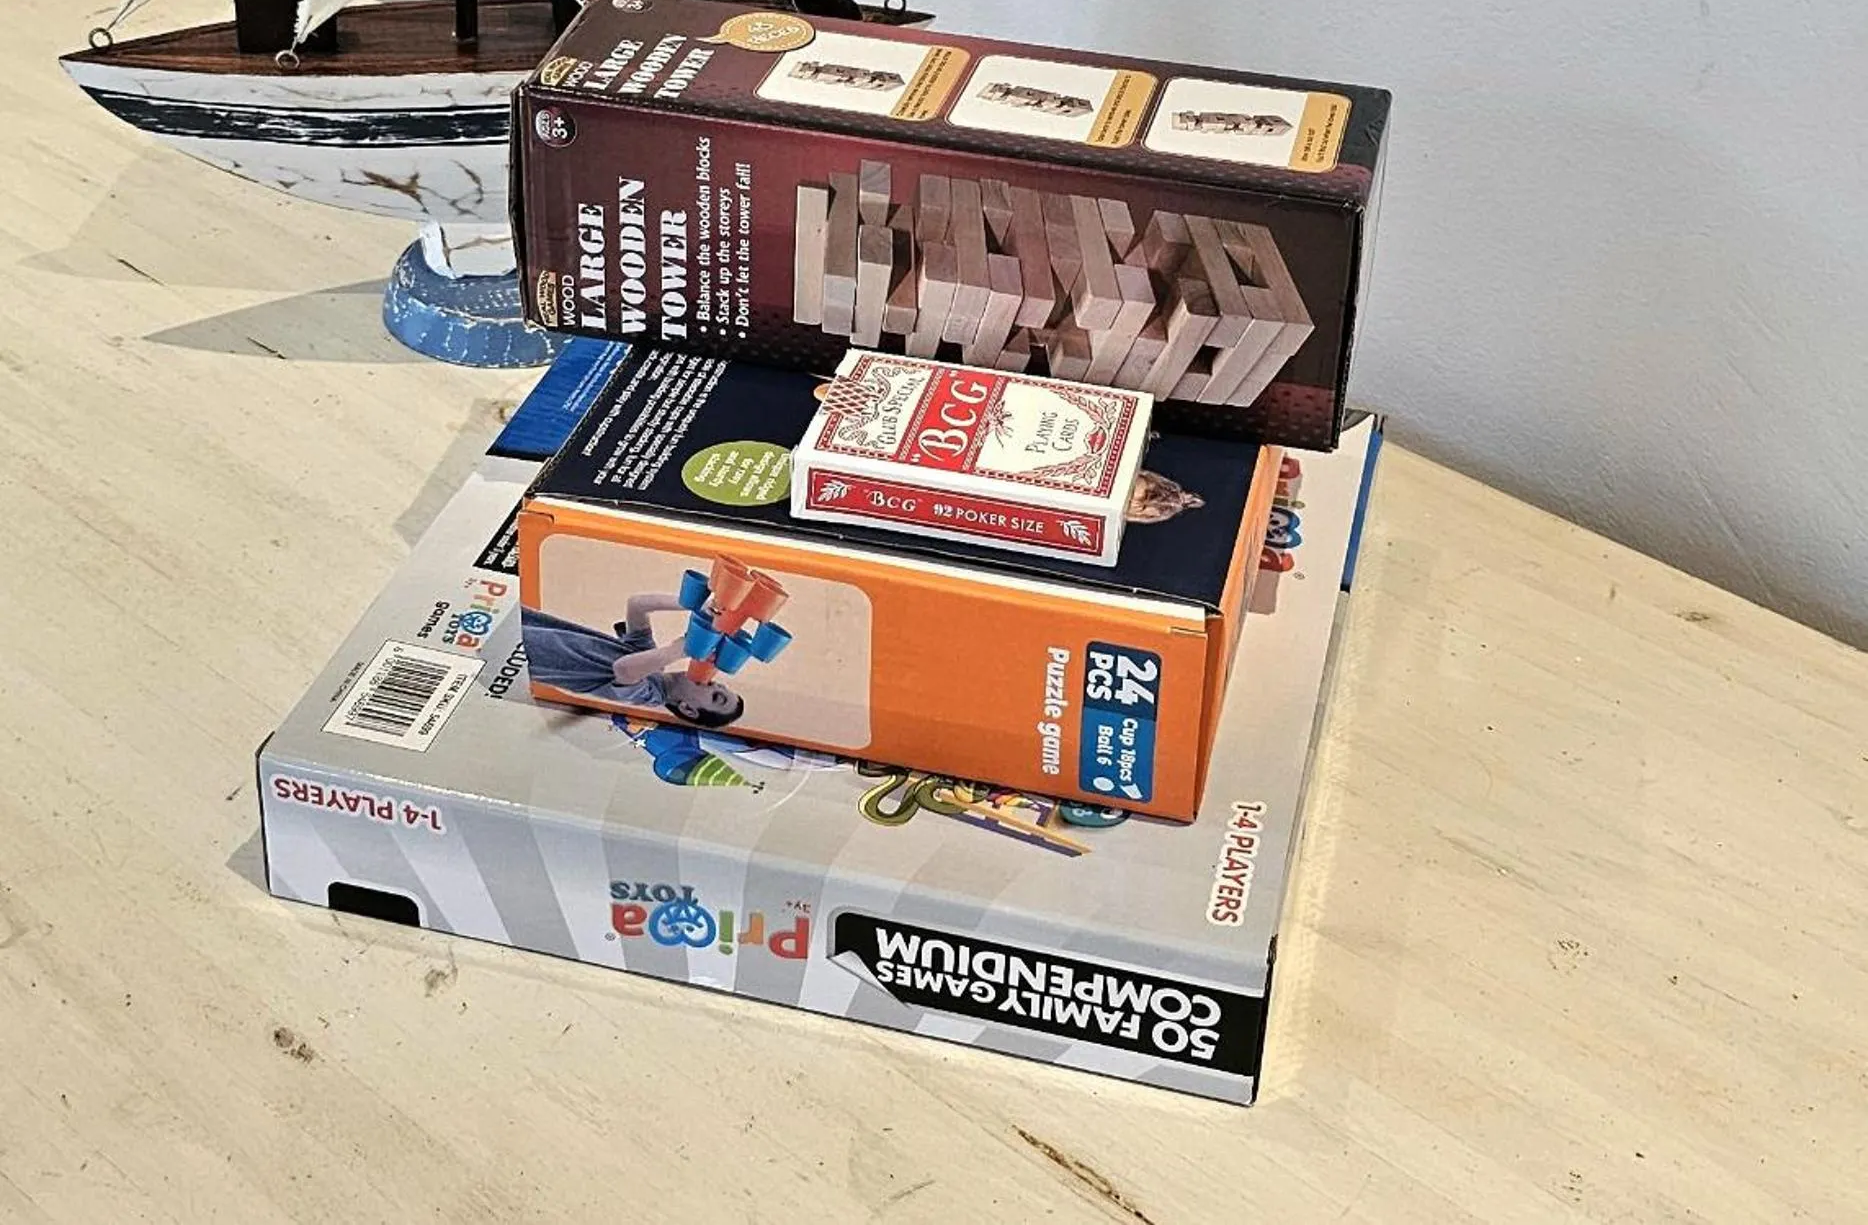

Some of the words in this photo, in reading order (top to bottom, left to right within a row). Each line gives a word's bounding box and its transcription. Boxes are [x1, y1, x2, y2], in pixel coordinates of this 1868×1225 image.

[562, 61, 594, 87] WOOD
[582, 39, 644, 90] LARGE
[617, 33, 688, 94] WOODEN
[653, 48, 715, 99] TOWER
[551, 116, 567, 139] 3+
[696, 137, 710, 181] blocks
[735, 163, 750, 190] fall!
[696, 184, 710, 241] wooden
[717, 188, 732, 237] storeys
[737, 195, 750, 234] tower
[578, 203, 607, 332] LARGE
[618, 176, 647, 334] WOODEN
[696, 244, 710, 266] the
[716, 241, 730, 265] the
[735, 240, 750, 261] the
[660, 209, 688, 341] TOWER
[719, 268, 732, 285] up
[736, 266, 750, 284] let
[561, 274, 576, 325] WOOD
[696, 270, 710, 321] Balance
[716, 289, 730, 324] Stack
[736, 284, 750, 327] Don't
[882, 376, 925, 414] SPECIAL
[1024, 410, 1059, 454] PLAYING
[1051, 418, 1080, 452] CARDS
[956, 507, 1007, 528] POKER
[1010, 517, 1046, 535] SIZE
[442, 614, 462, 644] TOYS
[1043, 646, 1071, 719] Puzzle
[1114, 654, 1158, 706] 24
[1037, 721, 1062, 775] game
[1096, 725, 1114, 756] Ball
[1119, 718, 1138, 747] Cup
[1097, 757, 1113, 766] 6
[1116, 747, 1137, 783] 18pcs
[274, 778, 393, 821] PLAYERS
[403, 804, 441, 831] 1-4
[1233, 804, 1262, 829] 1-4
[610, 880, 700, 906] TOYS
[1212, 834, 1255, 923] PLAYERS
[875, 927, 1222, 1027] COMPENDIUM
[876, 960, 996, 1003] GAMES
[999, 988, 1141, 1040] FAMILY
[1152, 1020, 1220, 1060] 50
